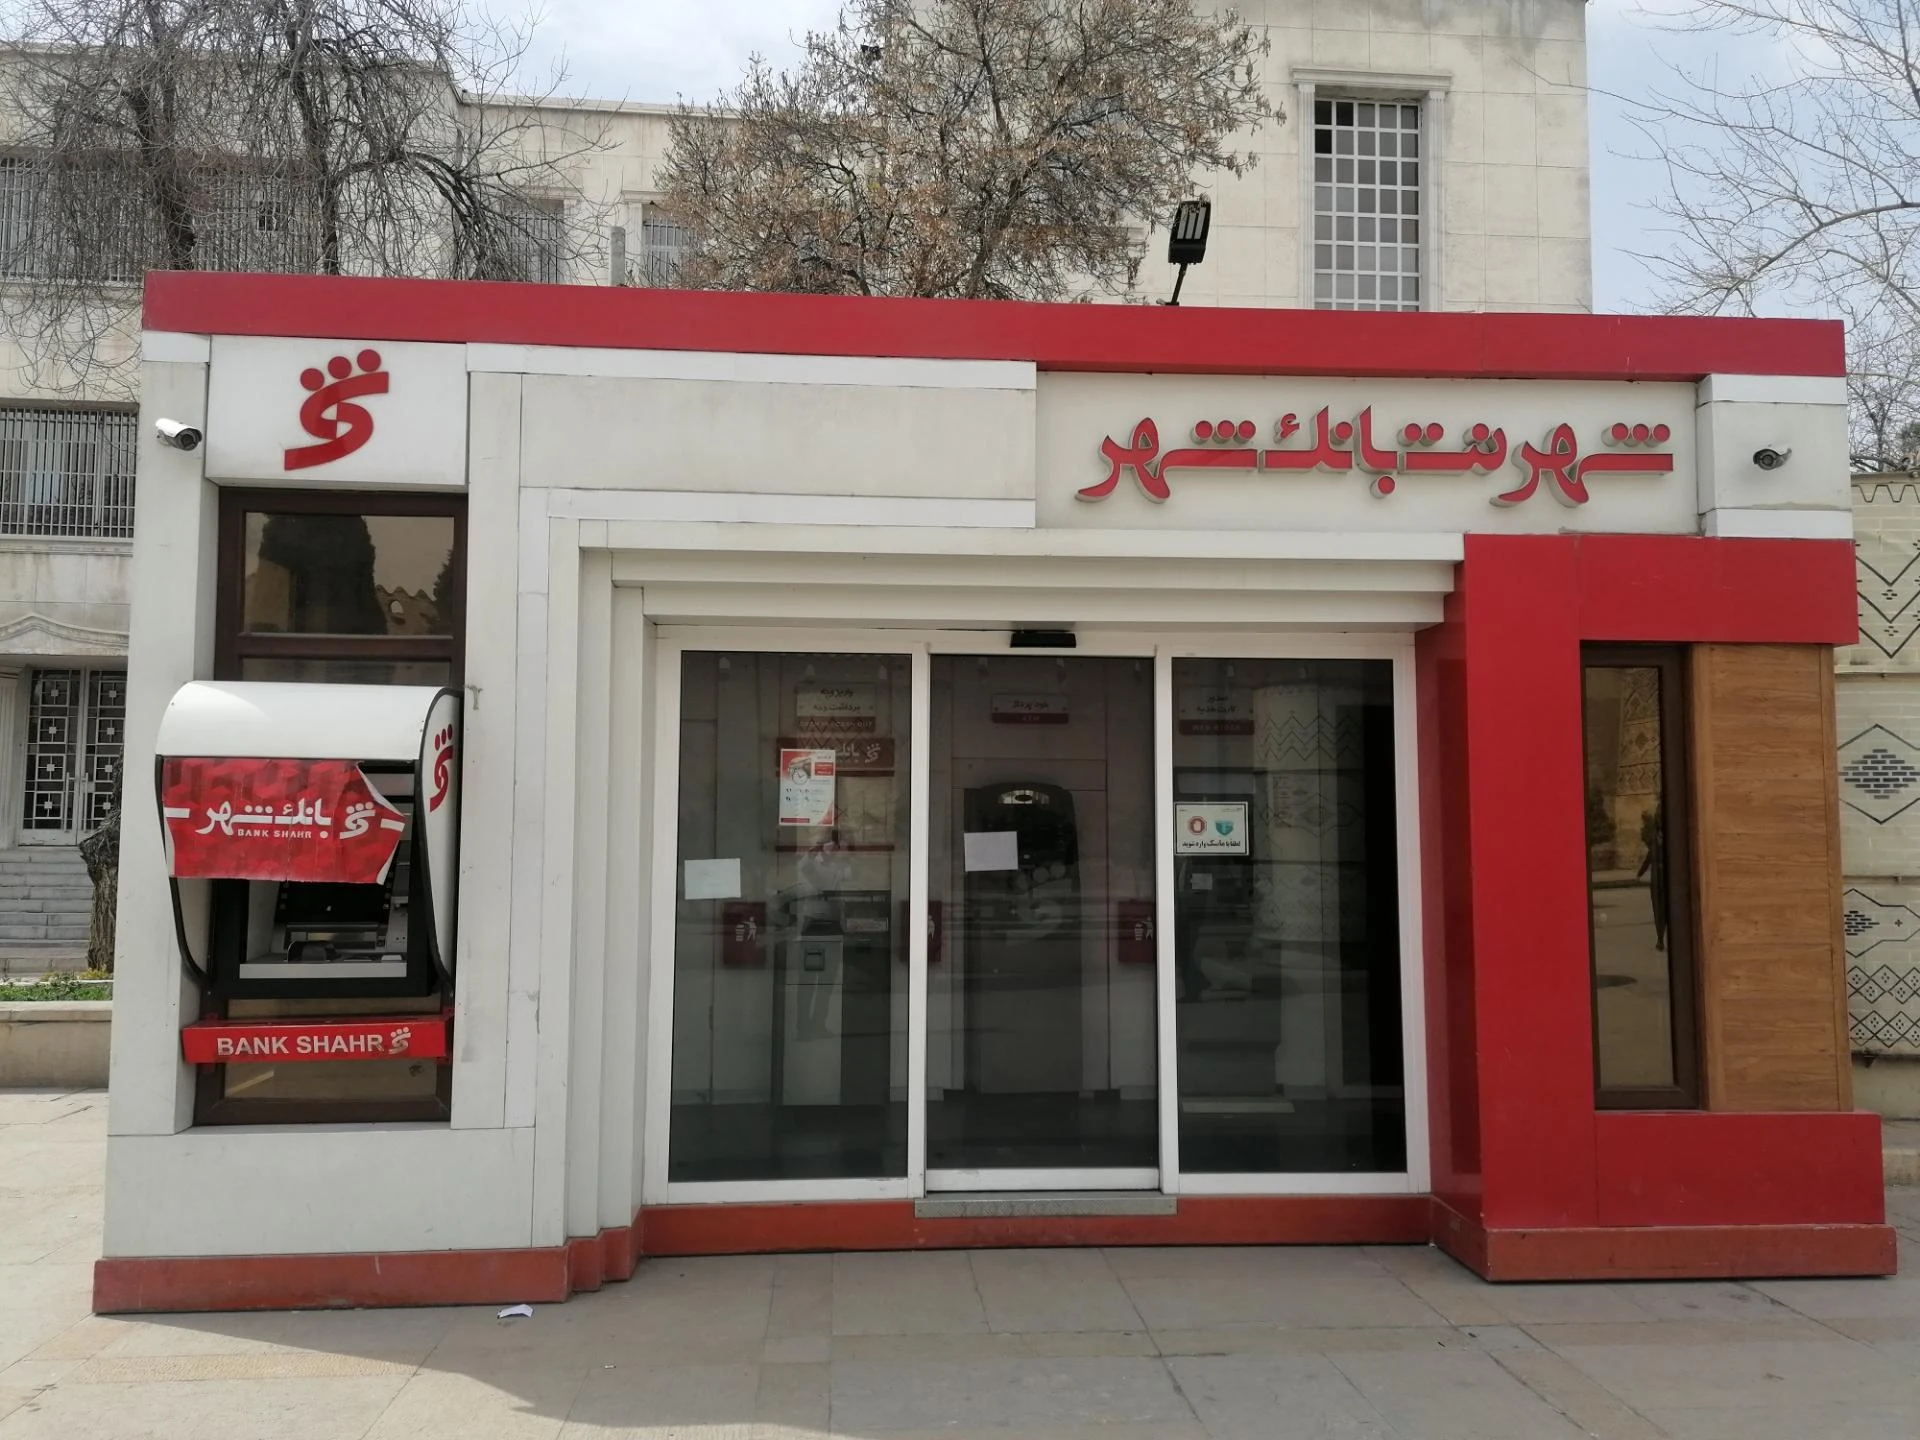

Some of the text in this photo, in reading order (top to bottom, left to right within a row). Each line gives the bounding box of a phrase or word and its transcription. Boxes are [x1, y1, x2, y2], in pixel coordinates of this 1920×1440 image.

[1074, 416, 1259, 504] شهر
[1257, 404, 1400, 499] بانک
[195, 798, 332, 840] بانک شهر
[237, 828, 312, 840] BANK SHAHR
[1196, 840, 1207, 849] وارد
[1207, 839, 1225, 847] ماسک
[216, 1034, 385, 1056] BANK SHAHR
